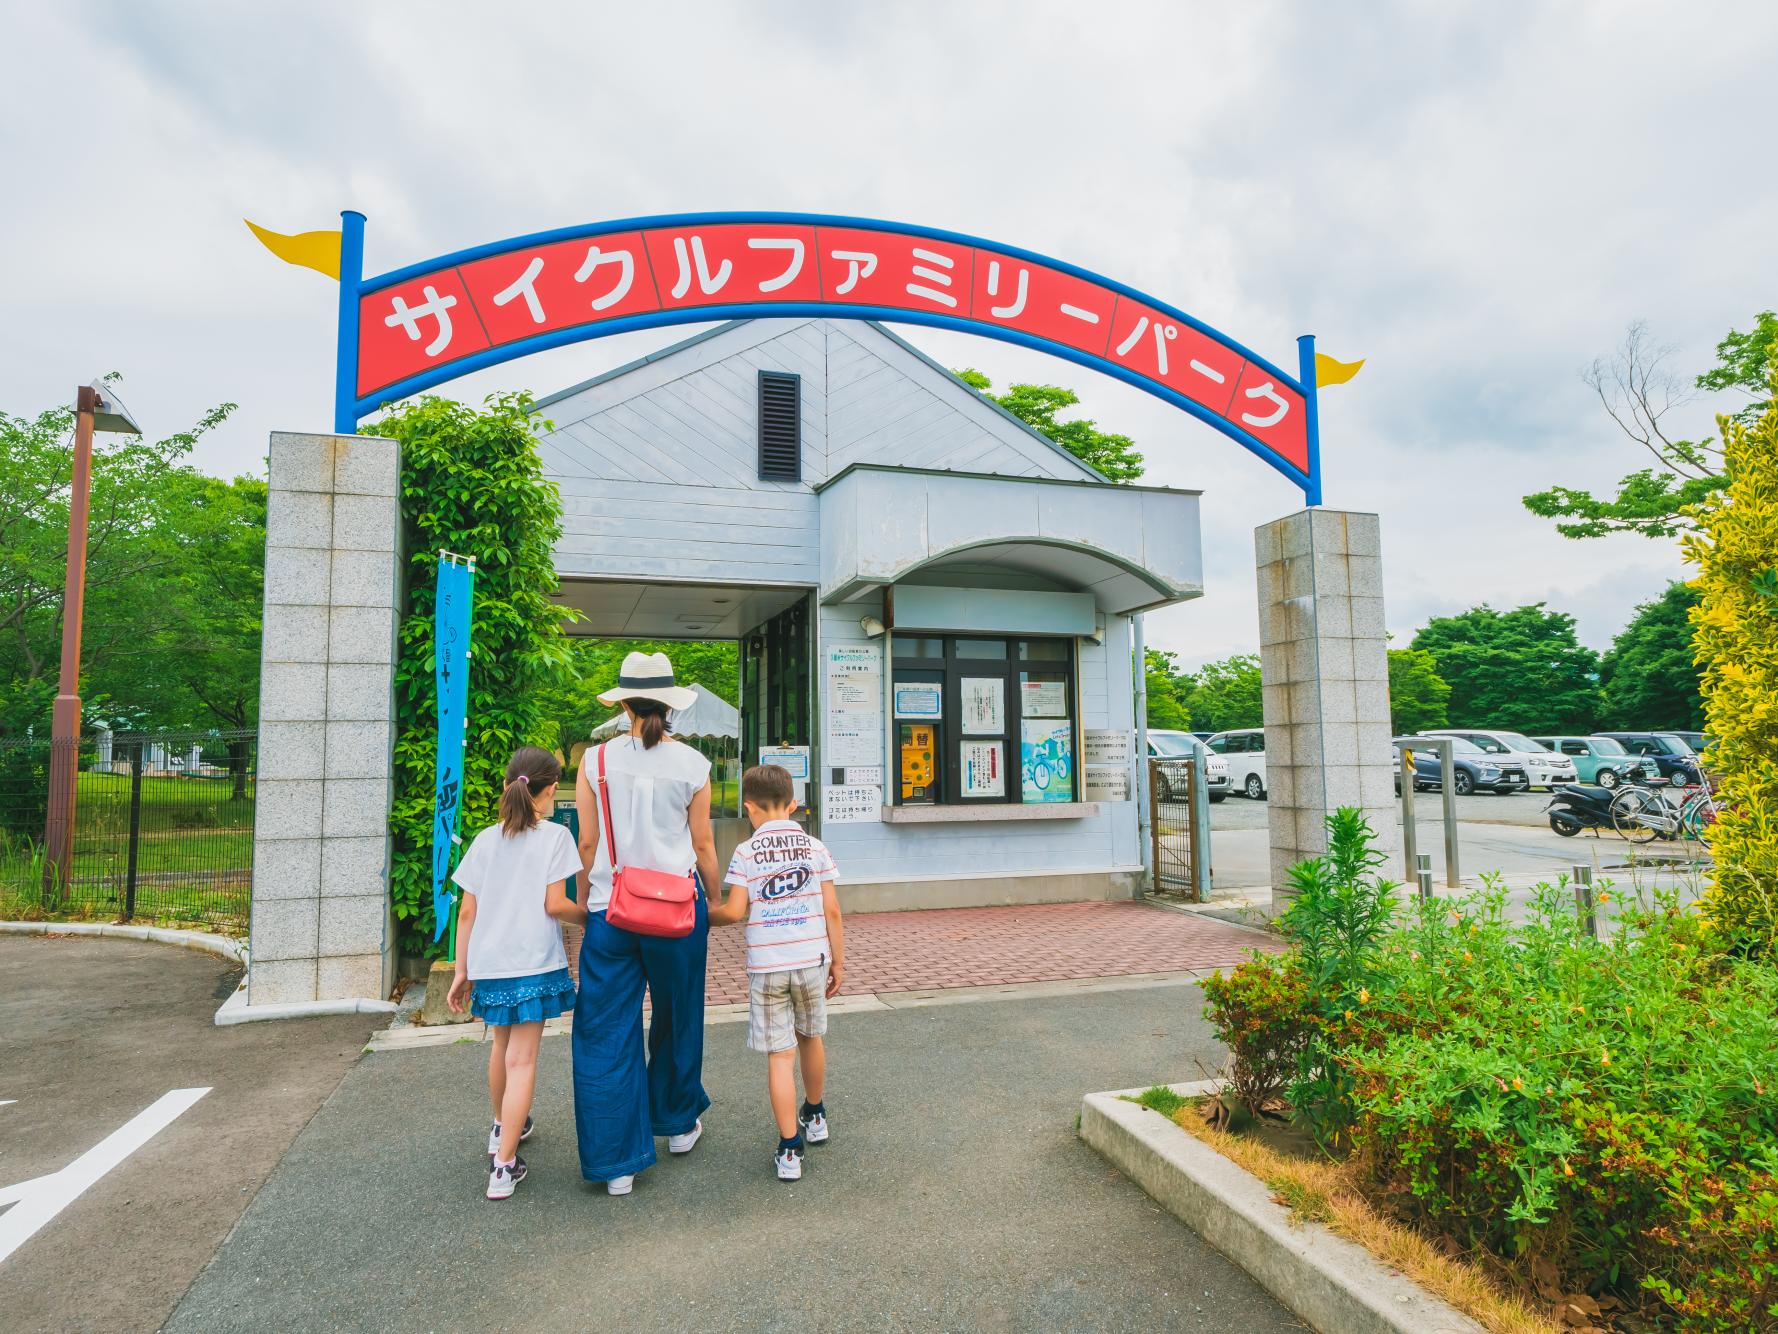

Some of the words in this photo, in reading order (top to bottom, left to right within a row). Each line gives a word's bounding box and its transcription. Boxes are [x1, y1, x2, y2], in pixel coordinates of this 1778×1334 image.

[384, 235, 1291, 429] サイクルファミリーパーク
[751, 835, 812, 851] COUNTER
[754, 847, 812, 865] CULTURE
